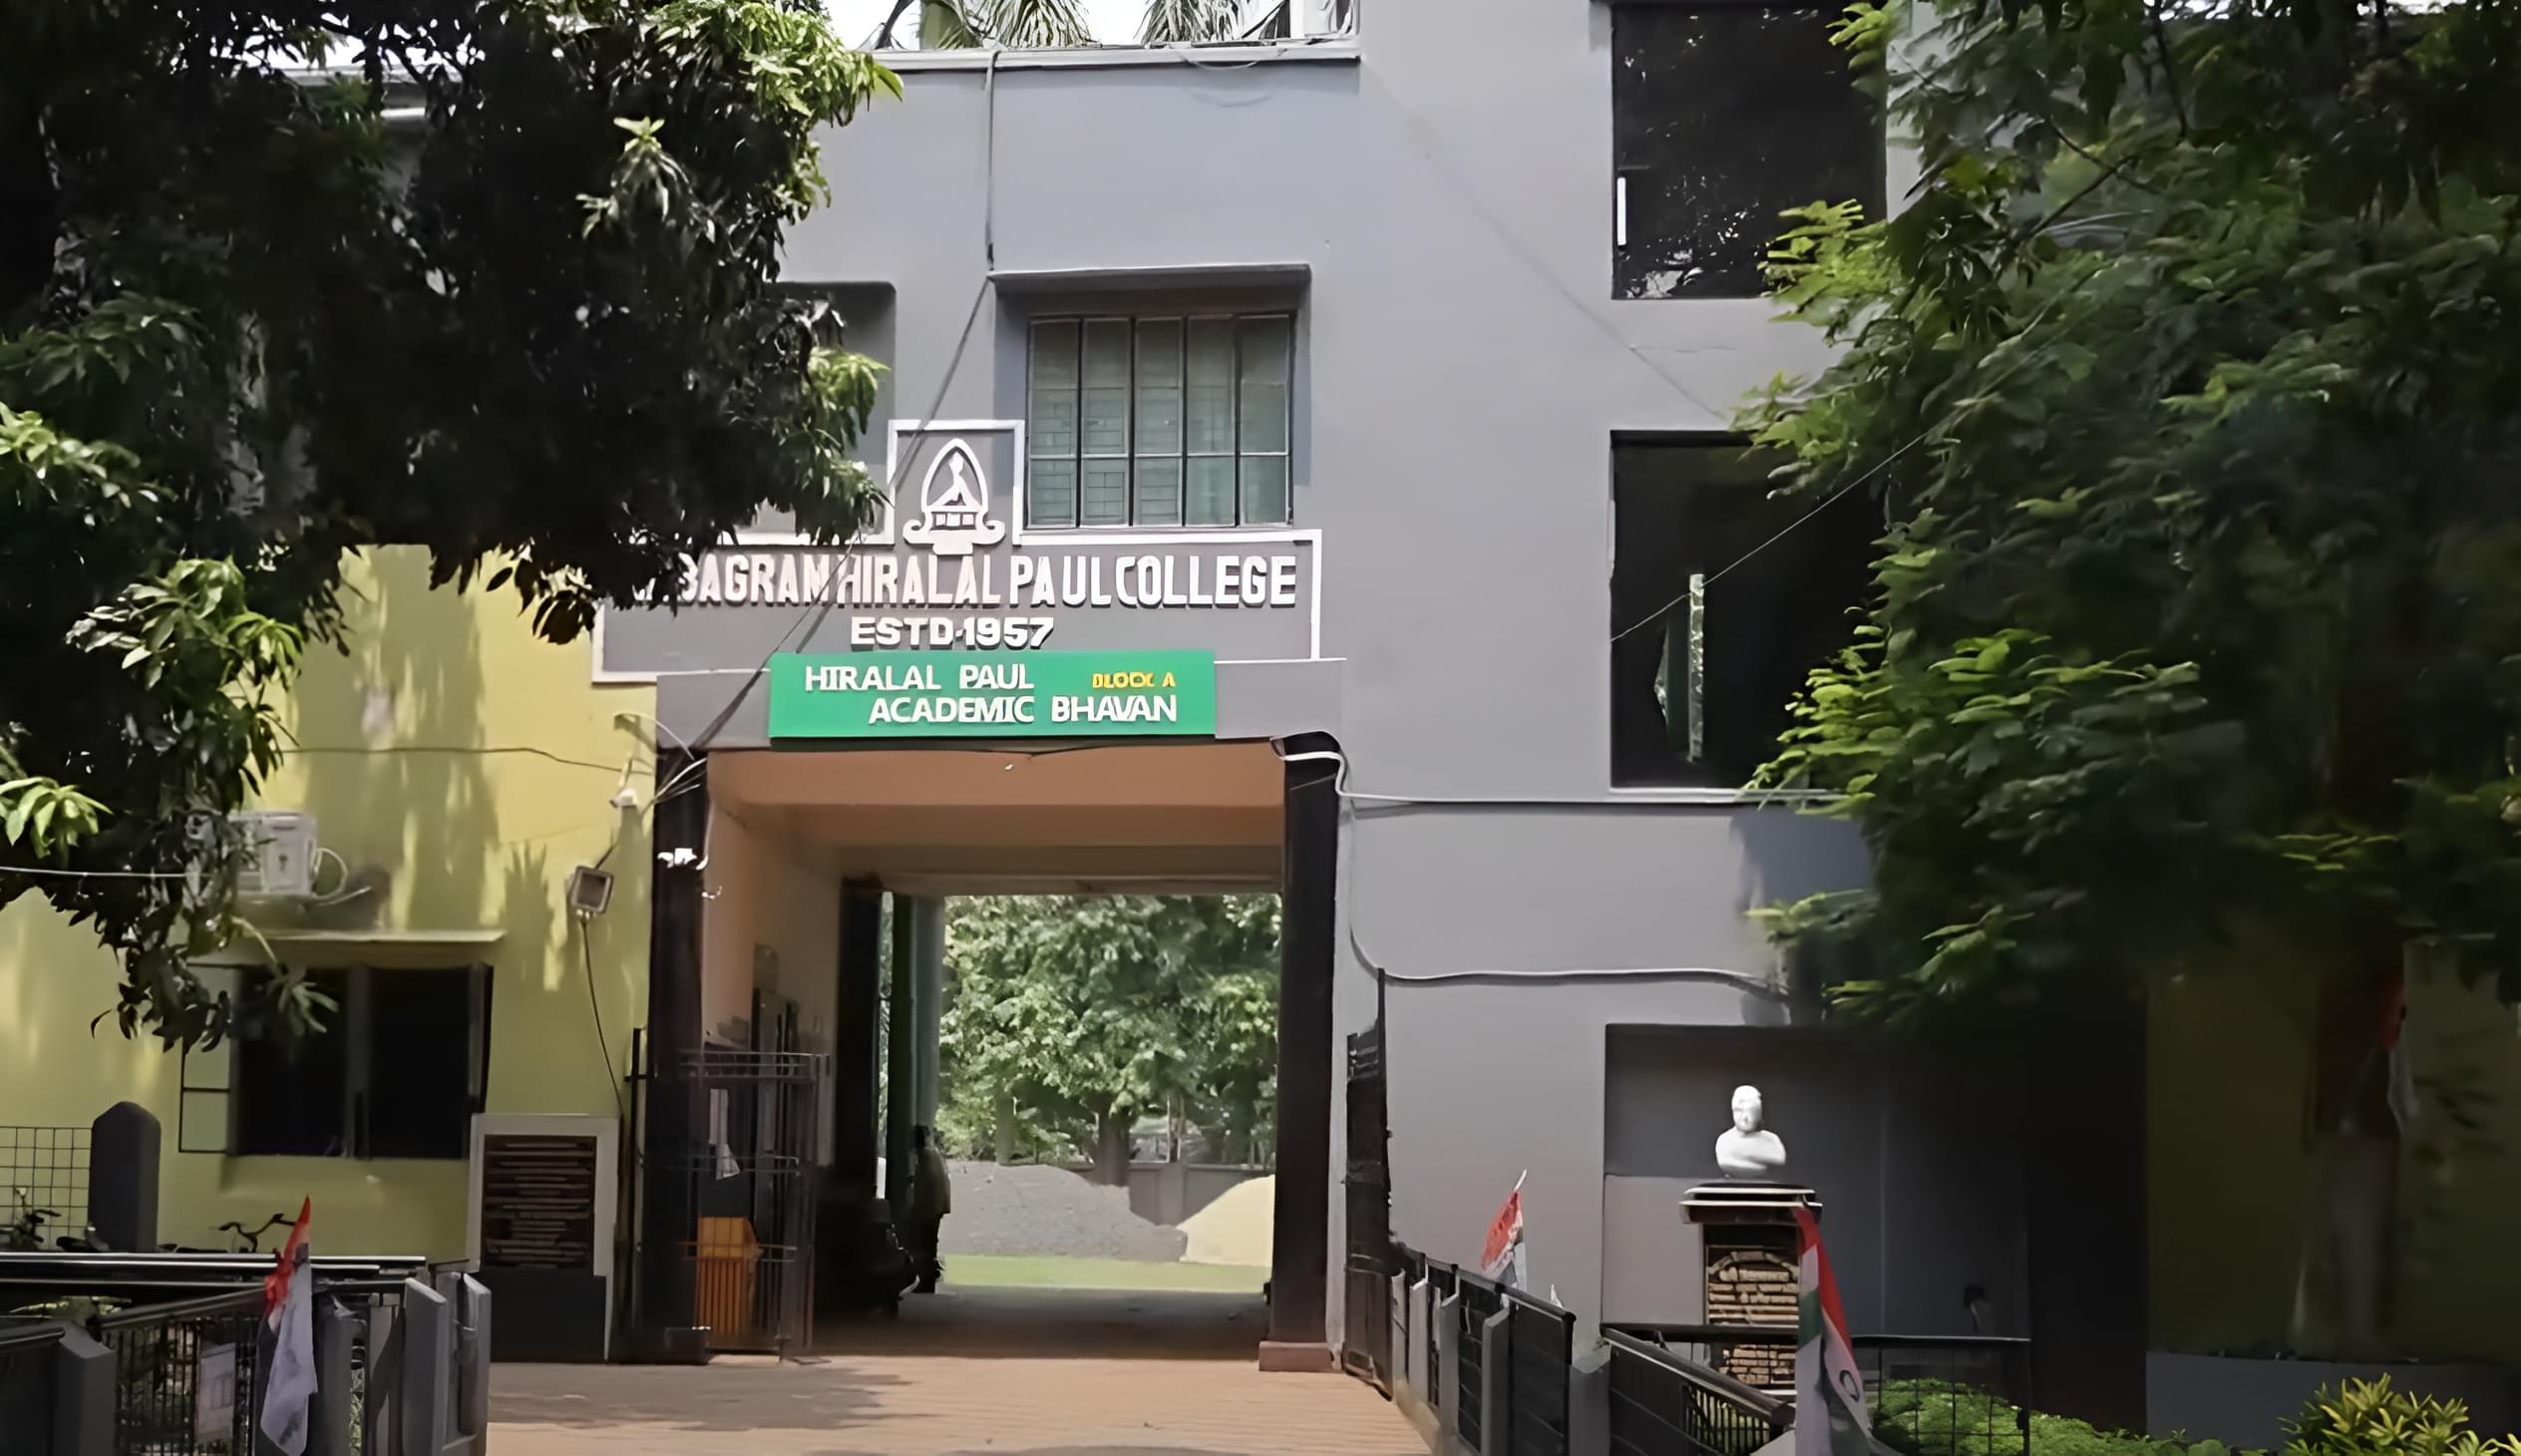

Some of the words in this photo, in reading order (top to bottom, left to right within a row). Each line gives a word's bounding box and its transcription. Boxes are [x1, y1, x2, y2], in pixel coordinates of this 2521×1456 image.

[632, 551, 830, 603] BAGRAM
[836, 553, 1000, 605] HIRALAL
[1009, 555, 1112, 606] PAUL
[1115, 555, 1296, 606] COLLEGE
[805, 665, 941, 691] HIRALAL
[959, 663, 1034, 689] PAUL
[1162, 671, 1176, 687] A
[868, 696, 1034, 724] ACADEMIC
[1051, 695, 1177, 722] BHAVAN
